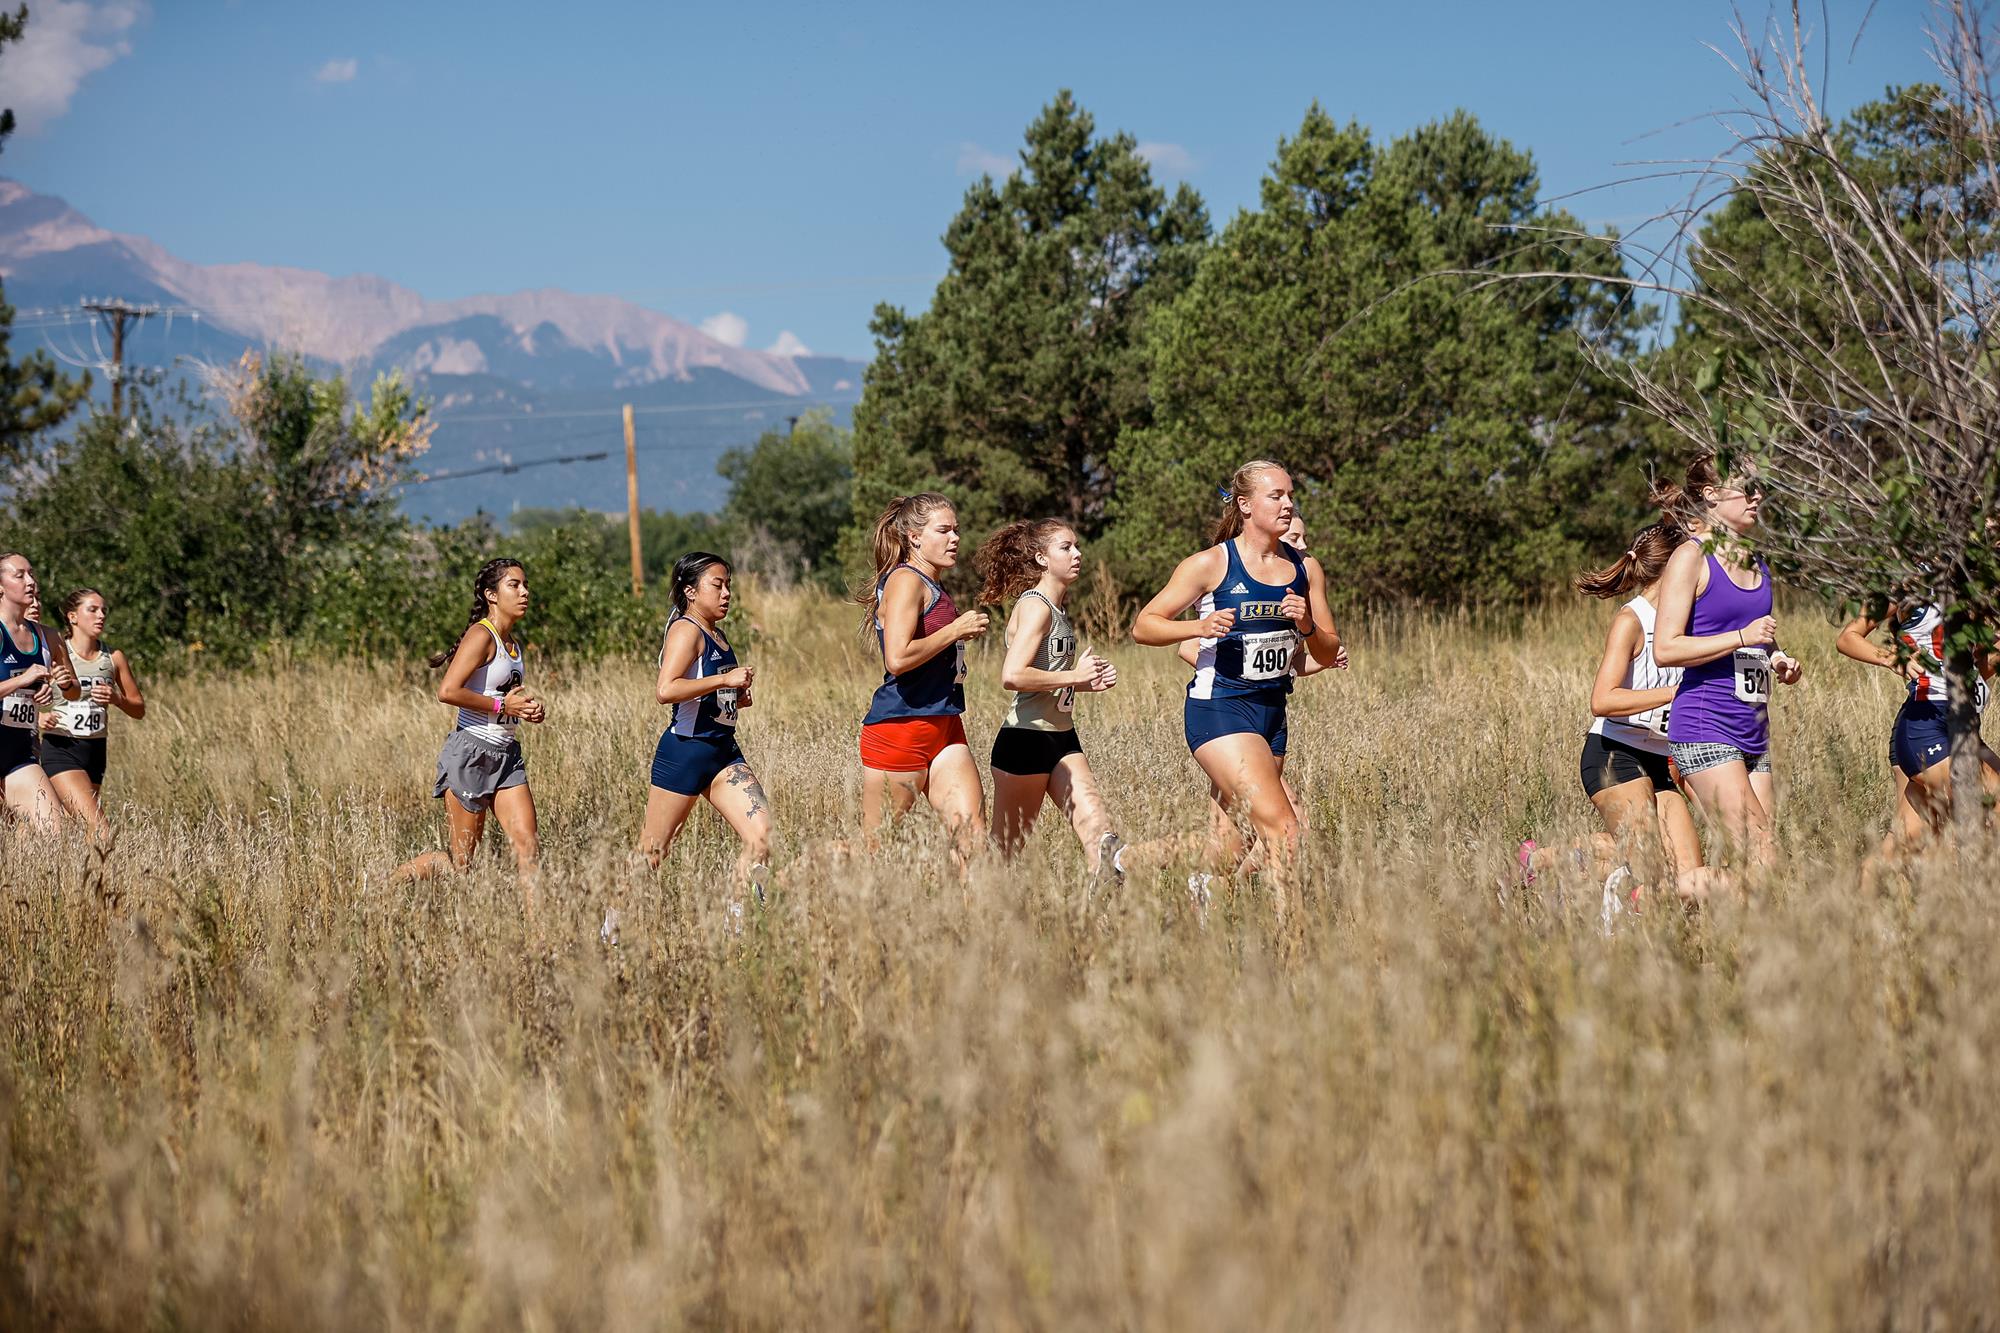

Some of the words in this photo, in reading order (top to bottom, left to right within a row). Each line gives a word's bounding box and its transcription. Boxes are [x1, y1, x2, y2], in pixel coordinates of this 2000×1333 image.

[1252, 648, 1287, 673] 490
[1744, 668, 1769, 695] 521
[9, 703, 35, 723] 486
[74, 714, 101, 731] 249
